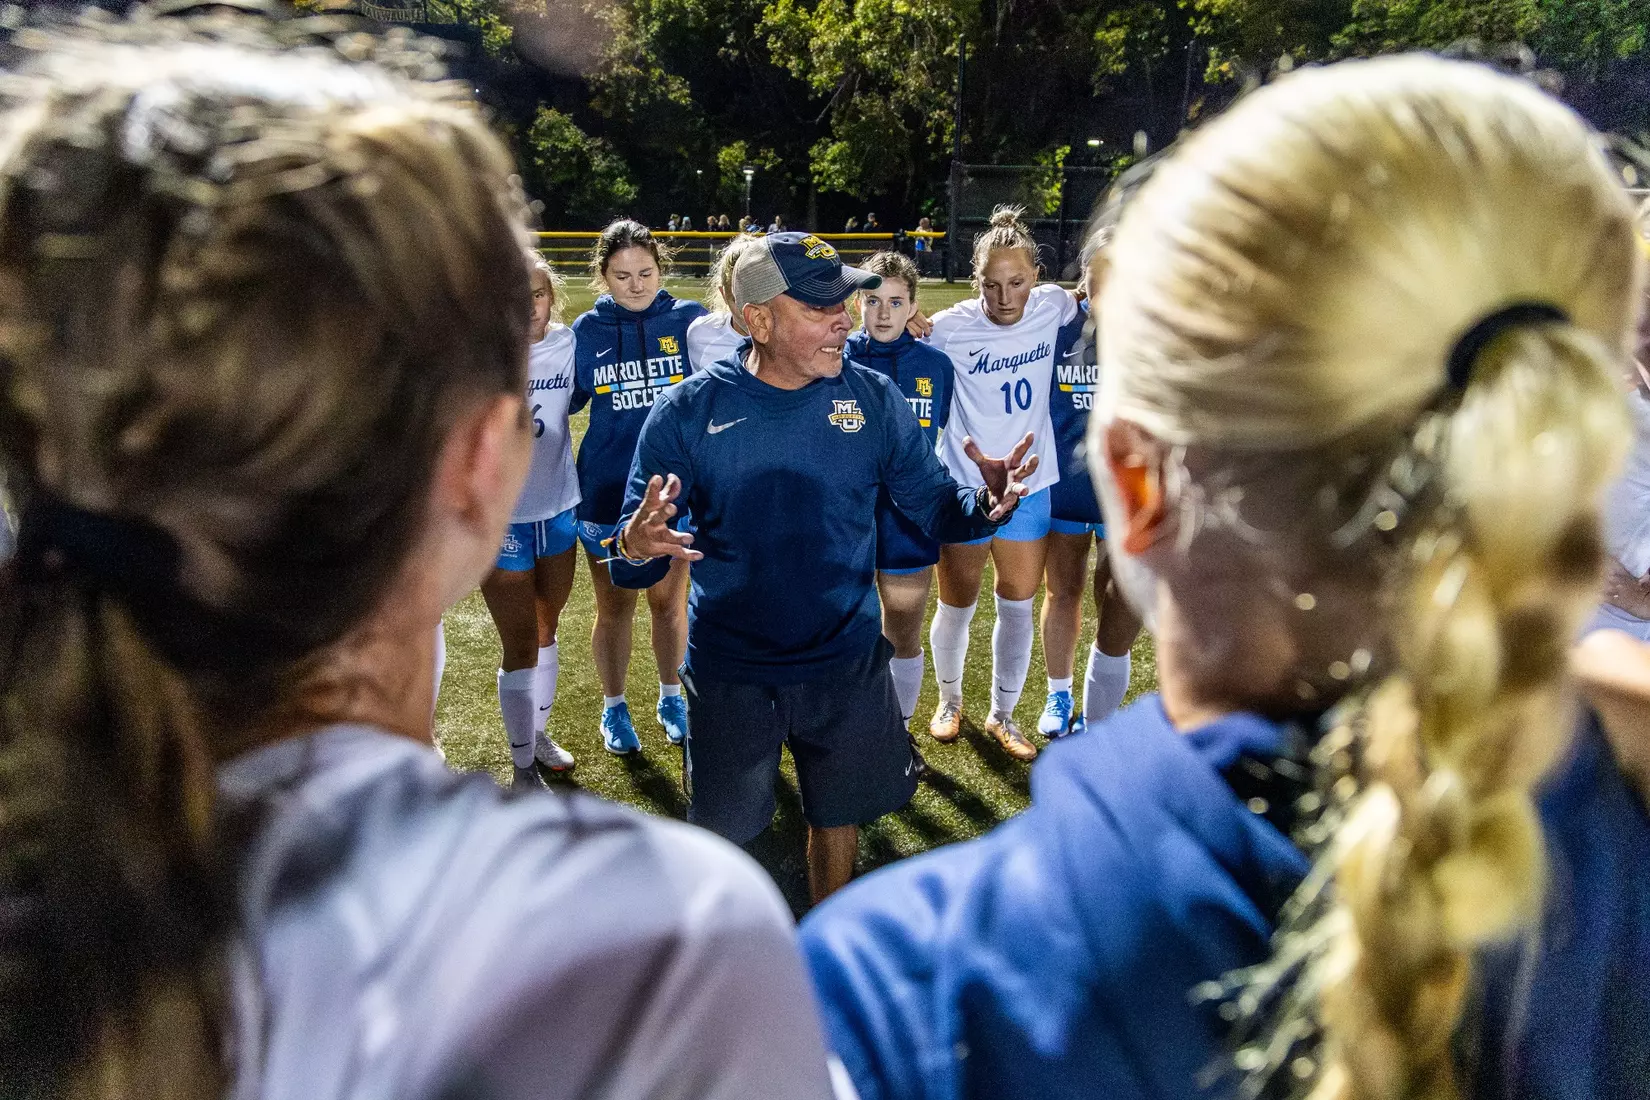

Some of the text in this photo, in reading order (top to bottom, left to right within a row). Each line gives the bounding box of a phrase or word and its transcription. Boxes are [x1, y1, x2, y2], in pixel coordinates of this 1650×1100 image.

[658, 336, 679, 355] MU
[968, 341, 1051, 375] Marquette
[915, 378, 933, 397] MU
[1000, 377, 1032, 415] 10
